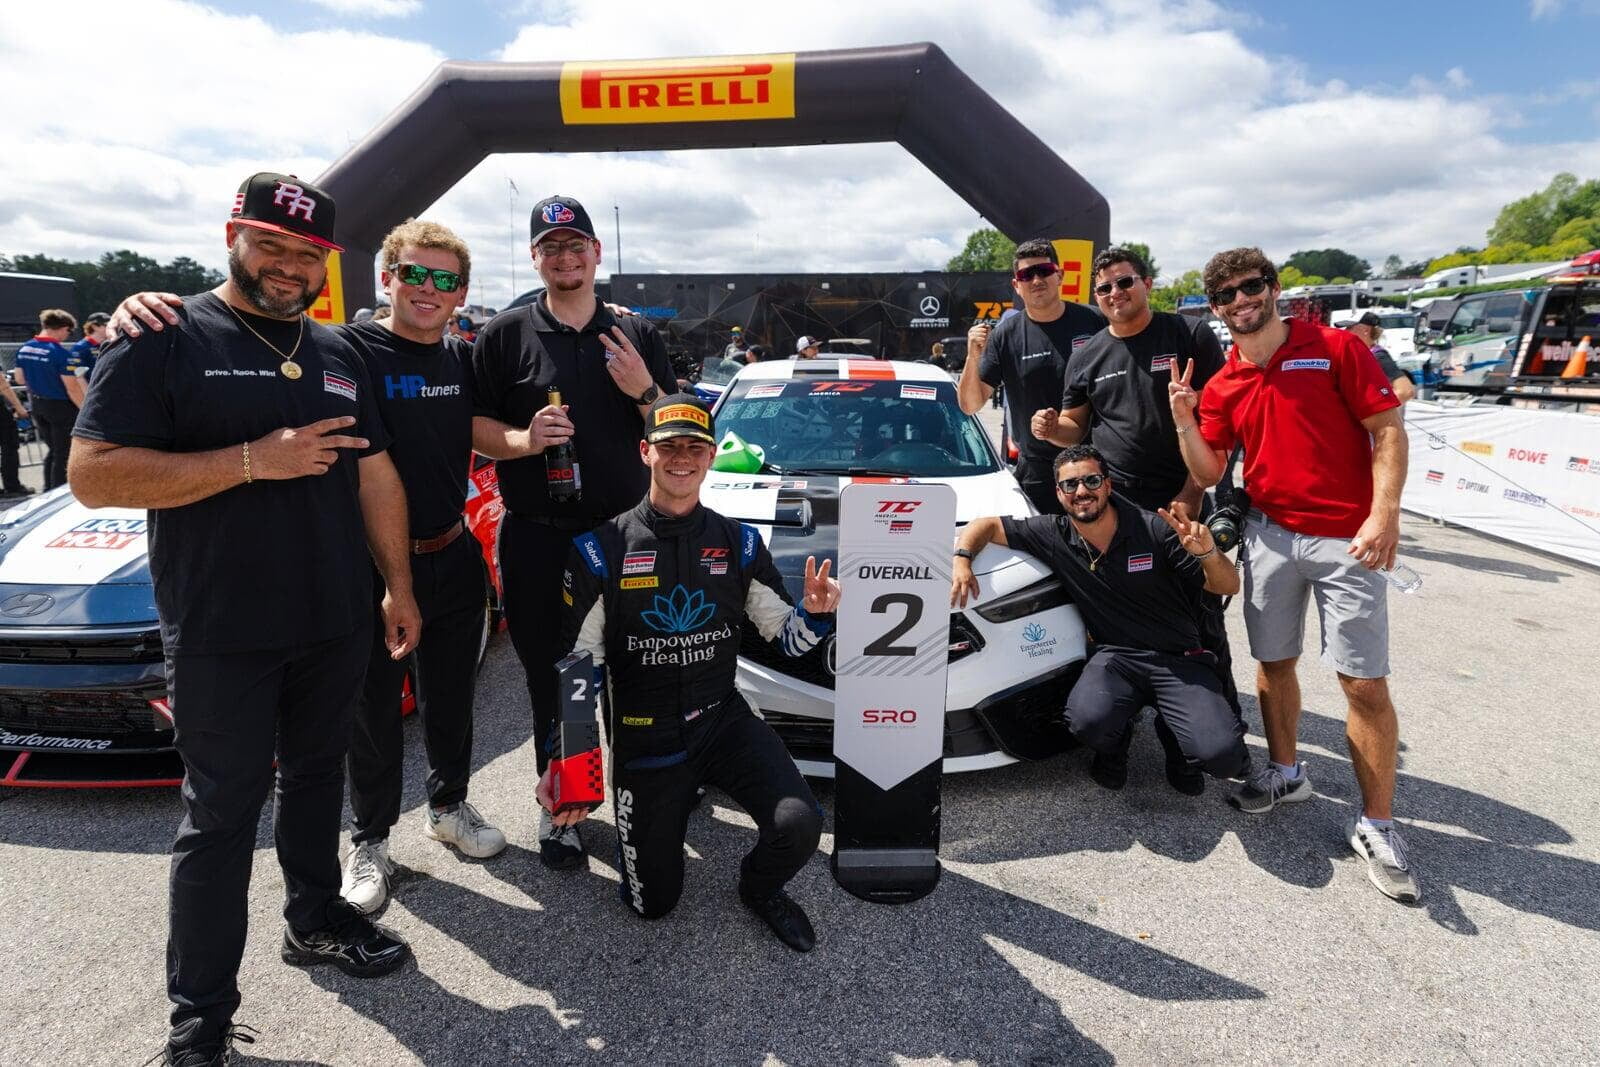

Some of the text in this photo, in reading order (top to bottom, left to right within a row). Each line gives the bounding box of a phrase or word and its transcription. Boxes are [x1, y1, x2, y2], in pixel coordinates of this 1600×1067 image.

[580, 63, 773, 109] PIRELLI
[205, 369, 231, 377] Drive.
[259, 369, 276, 377] Win!
[420, 384, 460, 398] tuners
[658, 408, 705, 425] PIRELLI
[1508, 447, 1548, 465] ROWE
[547, 468, 573, 480] RO
[1465, 481, 1490, 494] OPTIMA
[52, 531, 141, 548] MOLY
[584, 541, 602, 568] Sabelt
[858, 565, 934, 580] OVERALL
[863, 593, 924, 656] 2
[626, 622, 732, 652] Empowered
[641, 645, 716, 666] Healing
[571, 679, 588, 701] 2
[862, 710, 917, 723] SRO
[617, 787, 645, 914] Skip Barber
